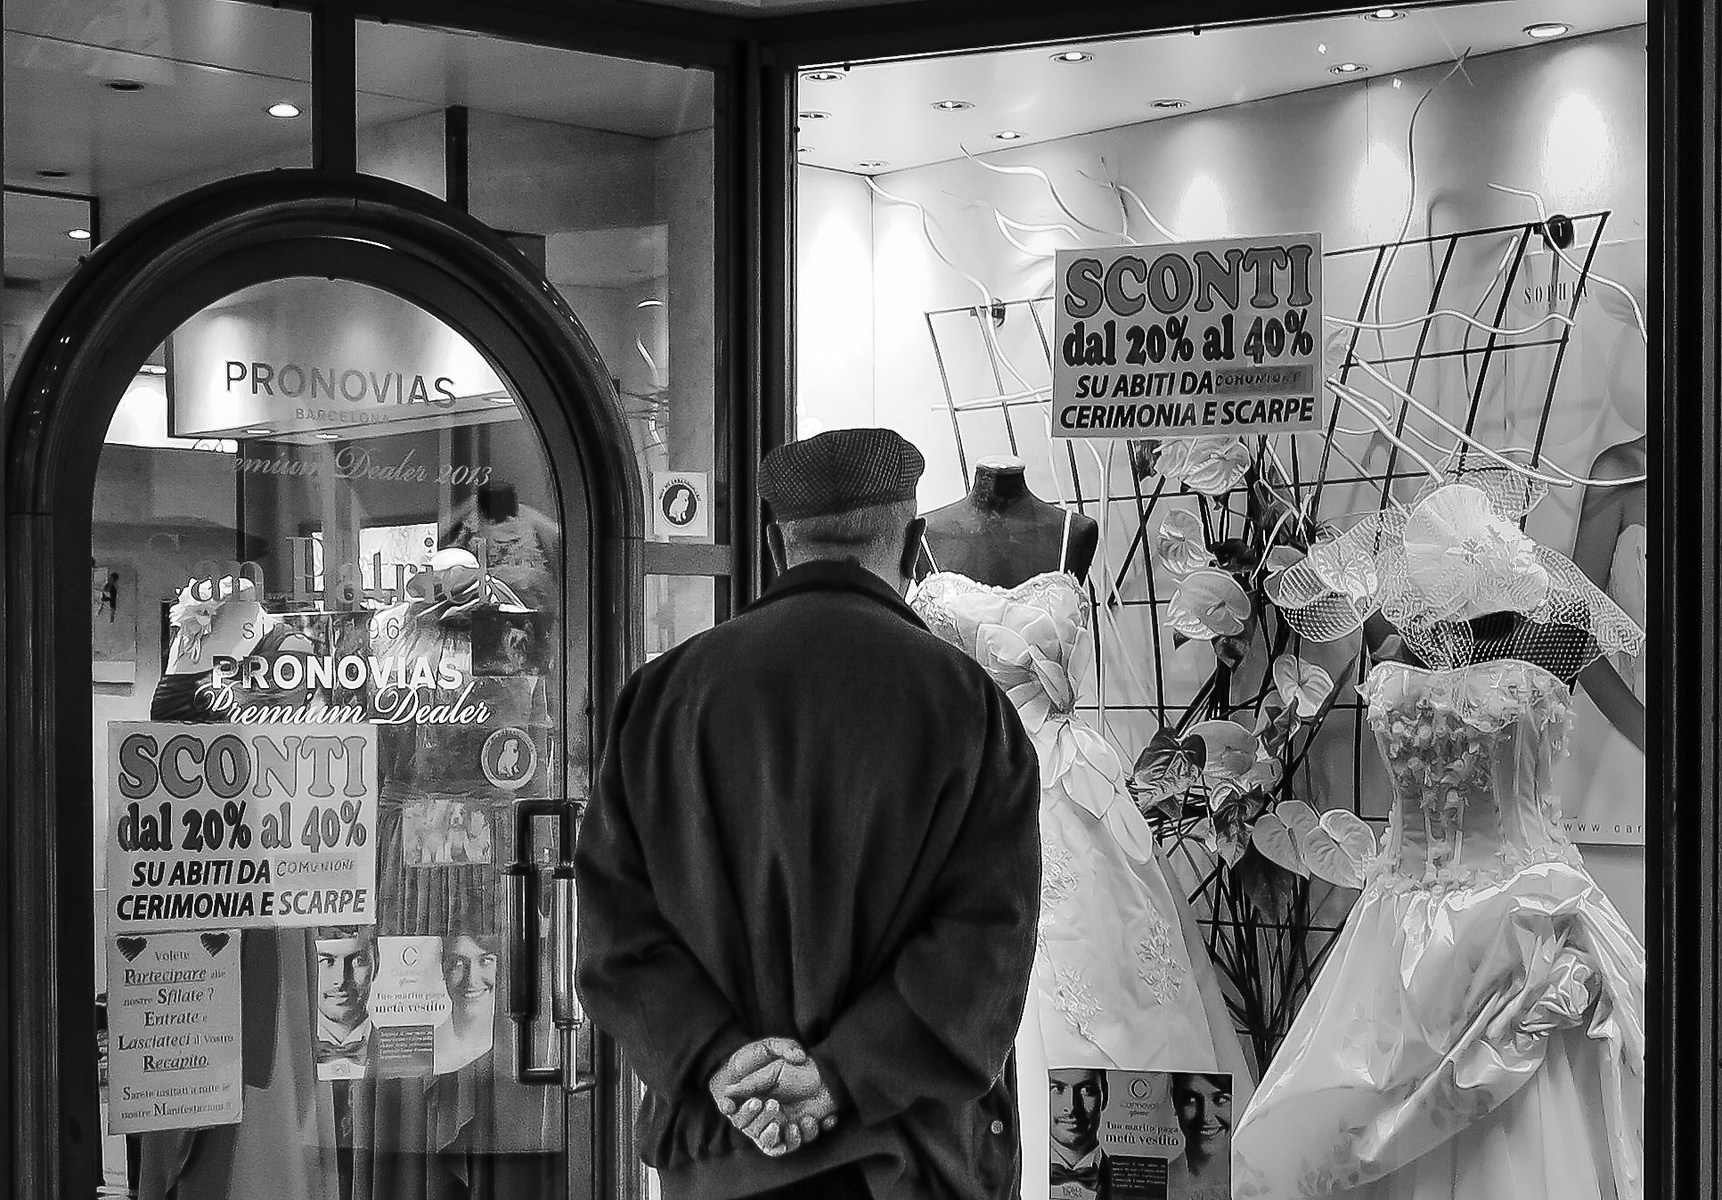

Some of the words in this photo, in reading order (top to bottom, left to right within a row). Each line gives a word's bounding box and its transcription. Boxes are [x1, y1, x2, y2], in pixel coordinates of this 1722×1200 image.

[1065, 245, 1313, 318] SCONTI
[1062, 320, 1117, 366] dal
[1125, 315, 1194, 366] 20%
[1202, 313, 1235, 361] al
[1243, 309, 1314, 366] 40%
[226, 360, 456, 408] PRONOVIAS
[1075, 375, 1107, 399] SU
[1112, 372, 1176, 398] ABITI
[1179, 371, 1214, 396] DA
[296, 407, 389, 424] BARCELONA
[1060, 402, 1197, 429] CERIMONIA
[1201, 401, 1218, 426] E
[1221, 397, 1314, 425] SCARPE
[334, 446, 427, 484] Dealer
[211, 654, 464, 690] PRONOVIAS
[195, 681, 367, 725] Premium
[369, 681, 490, 725] Dealer
[118, 733, 367, 799] SCONTI
[117, 801, 173, 852] dal
[182, 800, 251, 853] 20%
[260, 801, 292, 849] al
[301, 800, 367, 853] 40%
[131, 861, 166, 887] SU
[168, 859, 234, 886] ABITI
[236, 859, 271, 884] DA
[116, 892, 255, 921] CERIMONIA
[259, 891, 275, 916] E
[279, 889, 367, 915] SCARPE
[155, 950, 189, 961] Volete
[124, 968, 207, 986] Partecipare
[157, 988, 204, 1005] Sfilate
[408, 1001, 446, 1013] vestito
[144, 1010, 199, 1027] Entrate
[117, 1033, 190, 1051] Lasciateci
[1140, 1134, 1179, 1146] vestito
